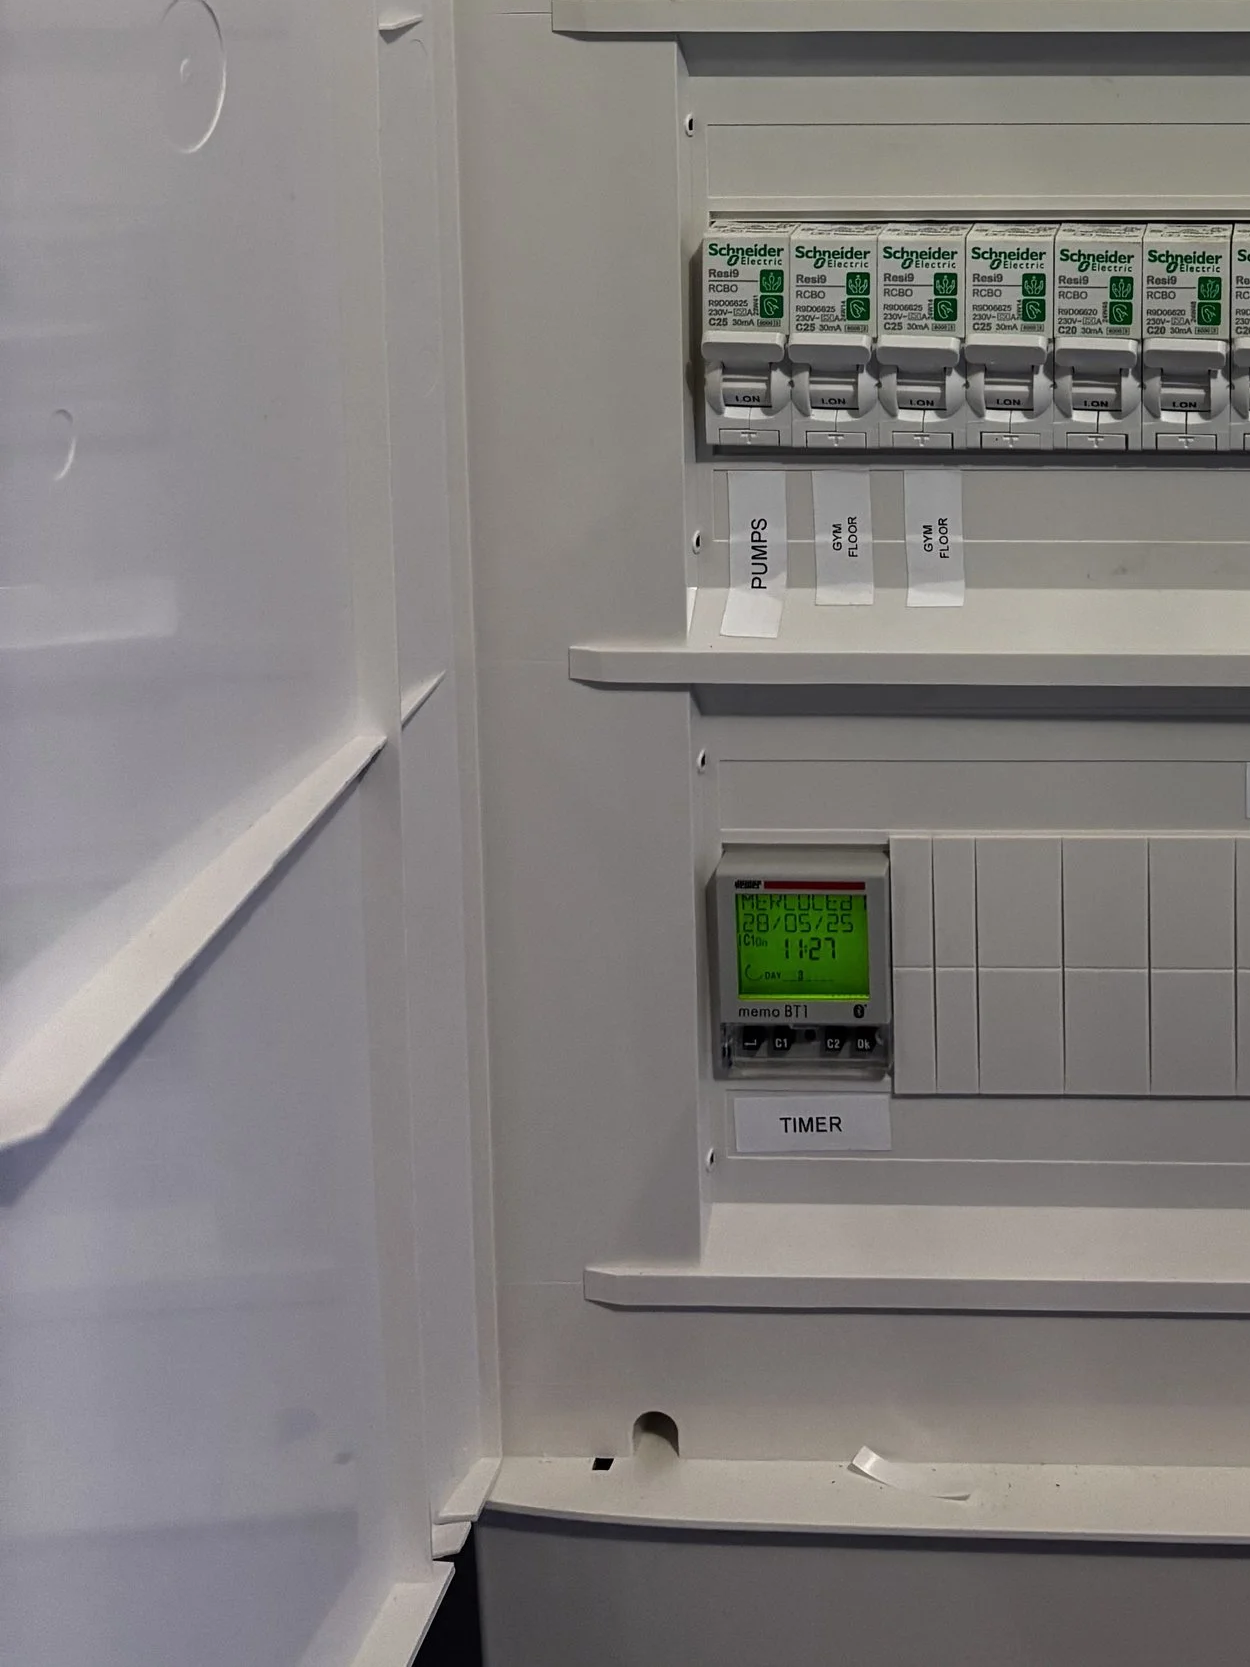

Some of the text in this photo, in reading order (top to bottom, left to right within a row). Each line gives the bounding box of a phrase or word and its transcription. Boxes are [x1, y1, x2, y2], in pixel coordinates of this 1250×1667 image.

[708, 243, 784, 258] Schneider
[795, 246, 871, 261] Schneider
[883, 246, 958, 261] Schneider
[971, 246, 1046, 262] Schneider
[1059, 249, 1134, 264] Schneider
[1147, 249, 1222, 265] Schneider
[1179, 262, 1221, 273] Electric
[1146, 291, 1176, 300] RCBO
[708, 317, 728, 326] C25
[831, 523, 843, 551] GYM
[847, 516, 858, 558] FLOOR
[922, 524, 934, 553] GYM
[937, 517, 950, 559] FLOOR
[750, 518, 768, 590] PUMPS
[743, 912, 853, 933] 28/05/25
[784, 936, 837, 961] 11:27
[738, 1004, 808, 1019] memo BT1
[826, 1038, 840, 1050] C2
[779, 1116, 843, 1134] TIMER
